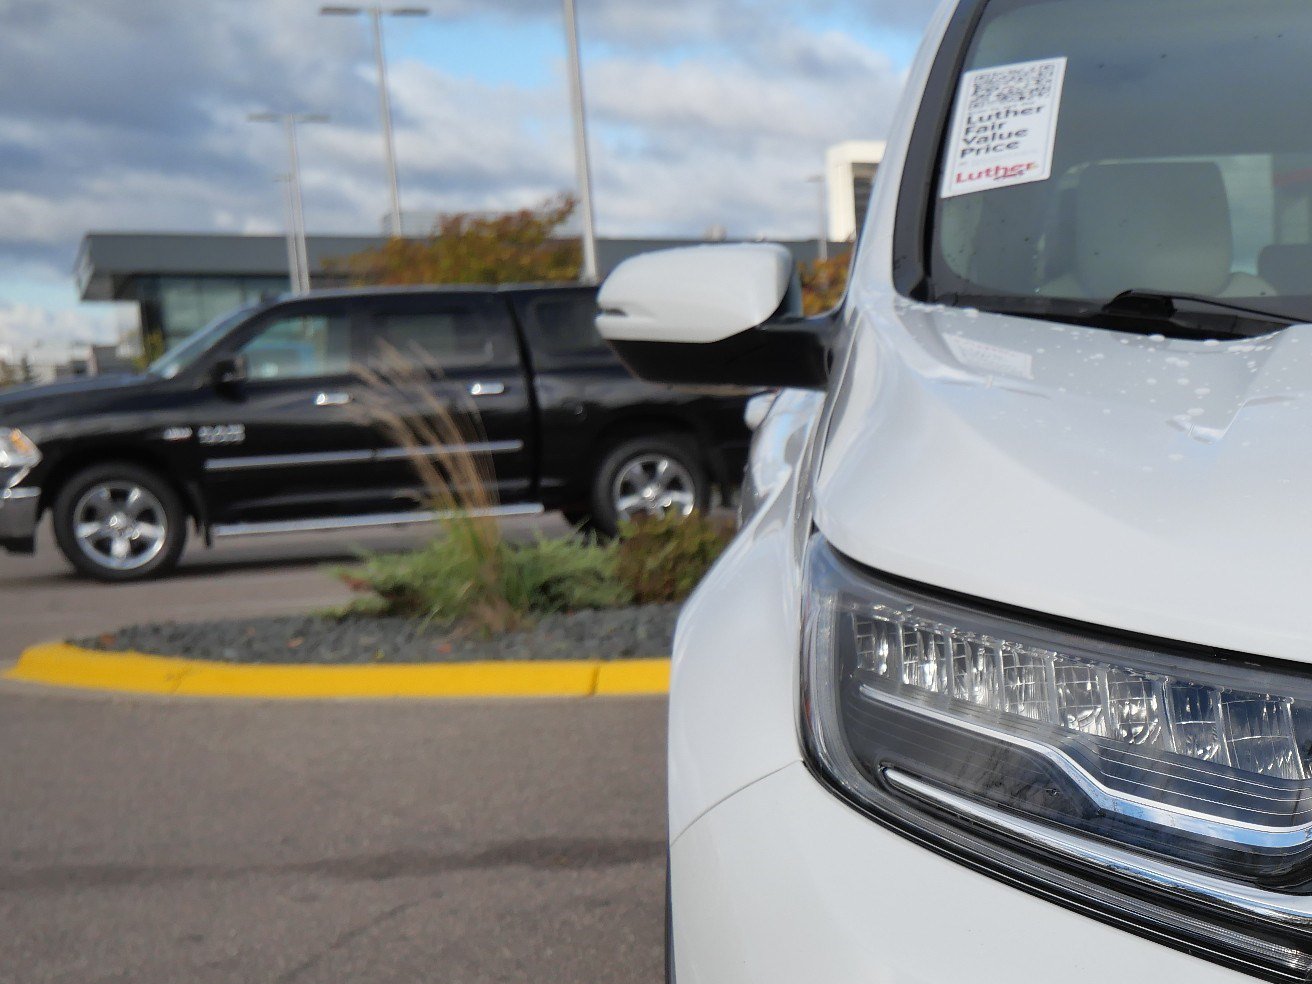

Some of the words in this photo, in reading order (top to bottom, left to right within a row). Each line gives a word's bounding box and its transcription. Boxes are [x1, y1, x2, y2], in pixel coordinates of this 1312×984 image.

[966, 105, 1045, 125] Luther
[962, 128, 1029, 146] Value
[964, 121, 1007, 136] Fair
[960, 140, 1021, 158] Price
[955, 161, 1036, 184] Luther
